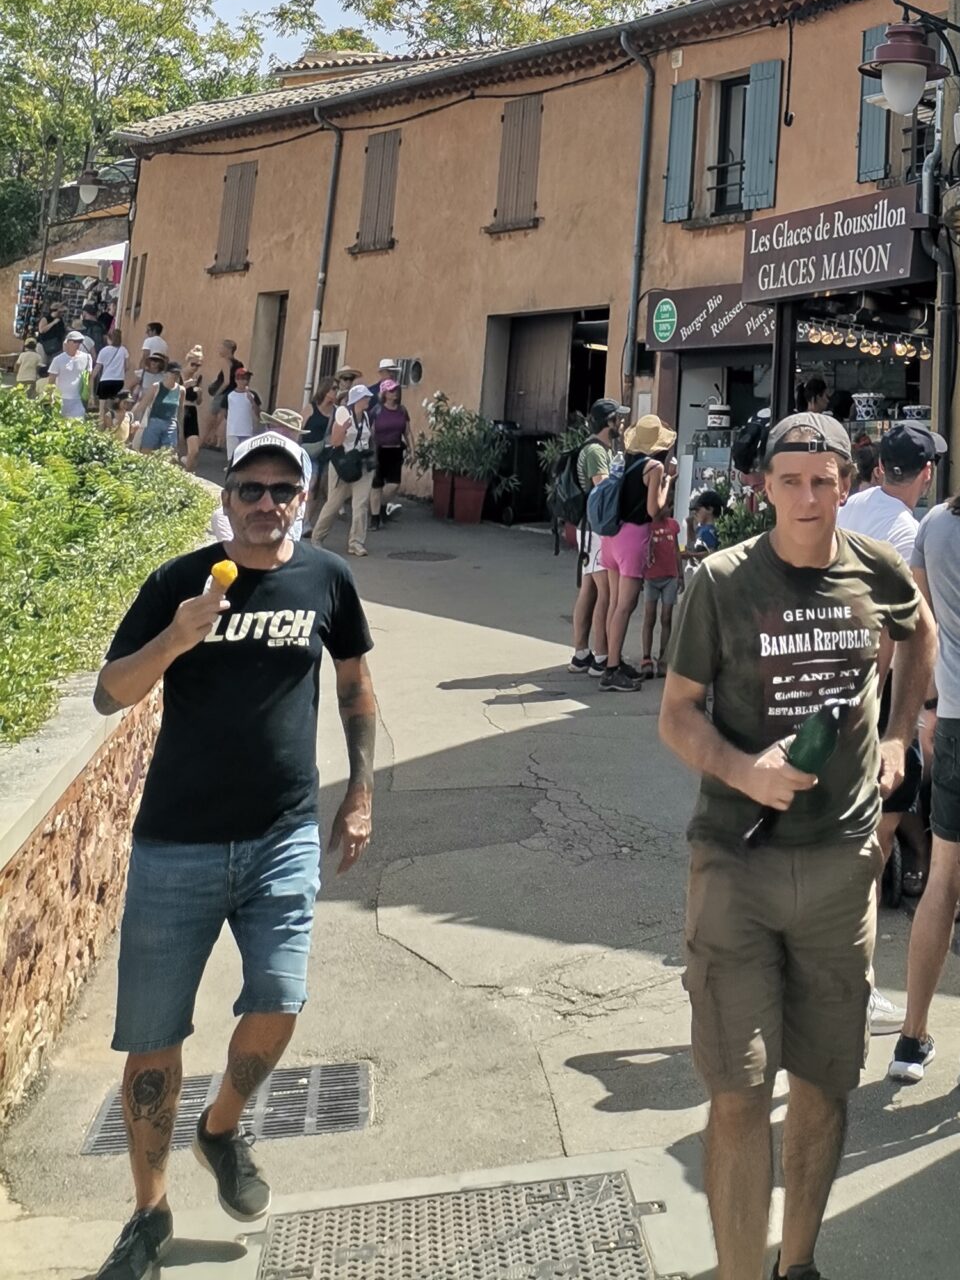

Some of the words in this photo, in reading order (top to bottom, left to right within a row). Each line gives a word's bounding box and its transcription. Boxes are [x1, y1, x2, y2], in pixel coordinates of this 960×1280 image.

[750, 227, 770, 255] Les
[772, 219, 812, 251] Glaces
[814, 212, 831, 241] de
[833, 198, 906, 236] Roussillon
[758, 257, 816, 291] GLACES
[820, 243, 892, 282] MAISON
[679, 309, 707, 342] Burger
[706, 294, 723, 314] Bio
[710, 301, 747, 338] Rôtisser
[744, 310, 767, 337] Plats
[203, 609, 316, 643] LUTCH
[782, 606, 853, 622] GENUINE
[760, 633, 811, 657] BANANA
[799, 672, 836, 682] AND
